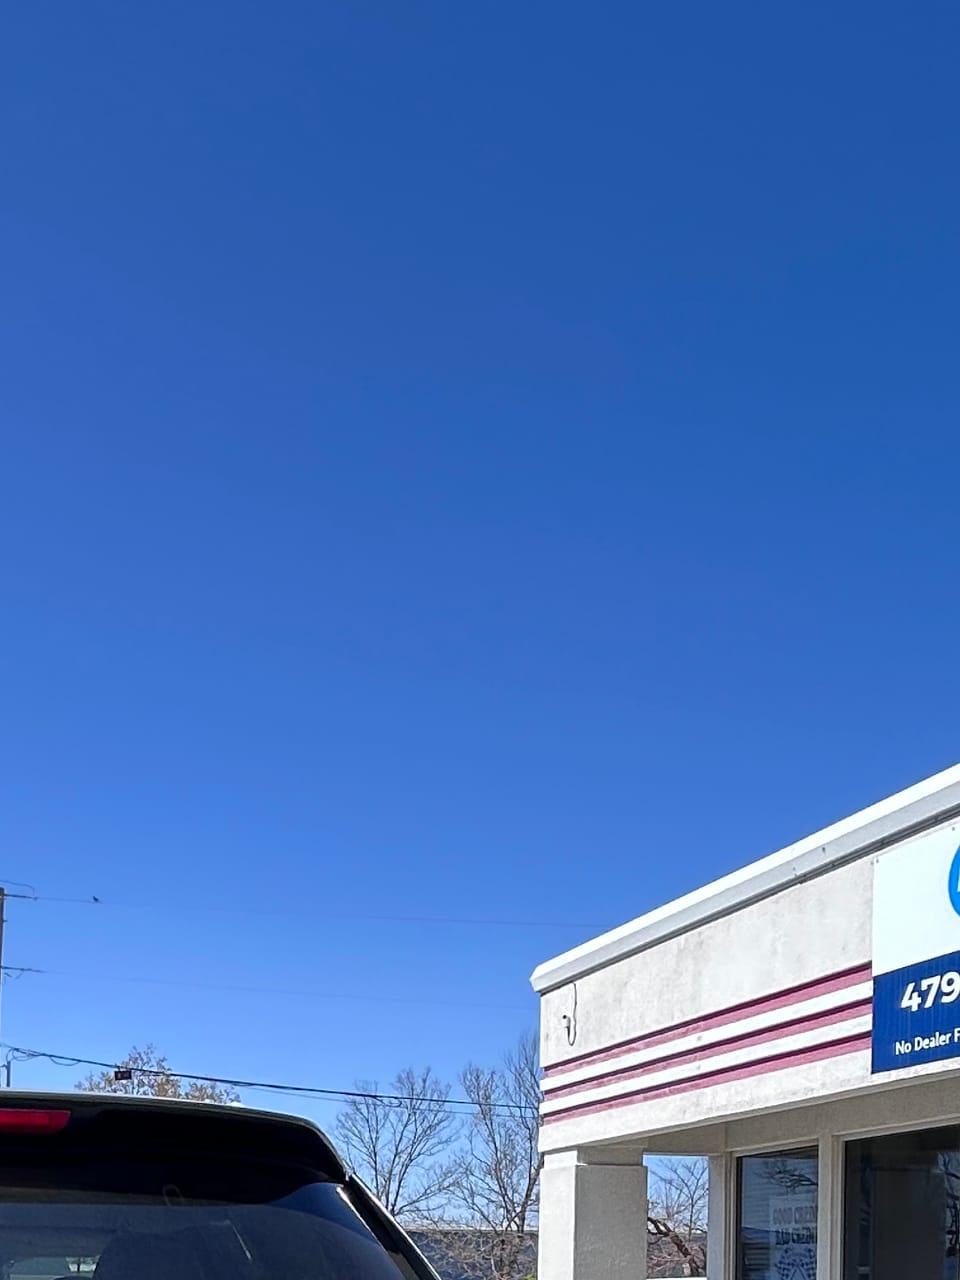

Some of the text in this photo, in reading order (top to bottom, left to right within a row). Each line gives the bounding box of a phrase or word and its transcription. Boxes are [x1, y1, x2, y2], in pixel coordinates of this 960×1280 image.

[901, 971, 960, 1012] 479
[895, 1040, 912, 1055] No
[914, 1031, 952, 1051] Dealer
